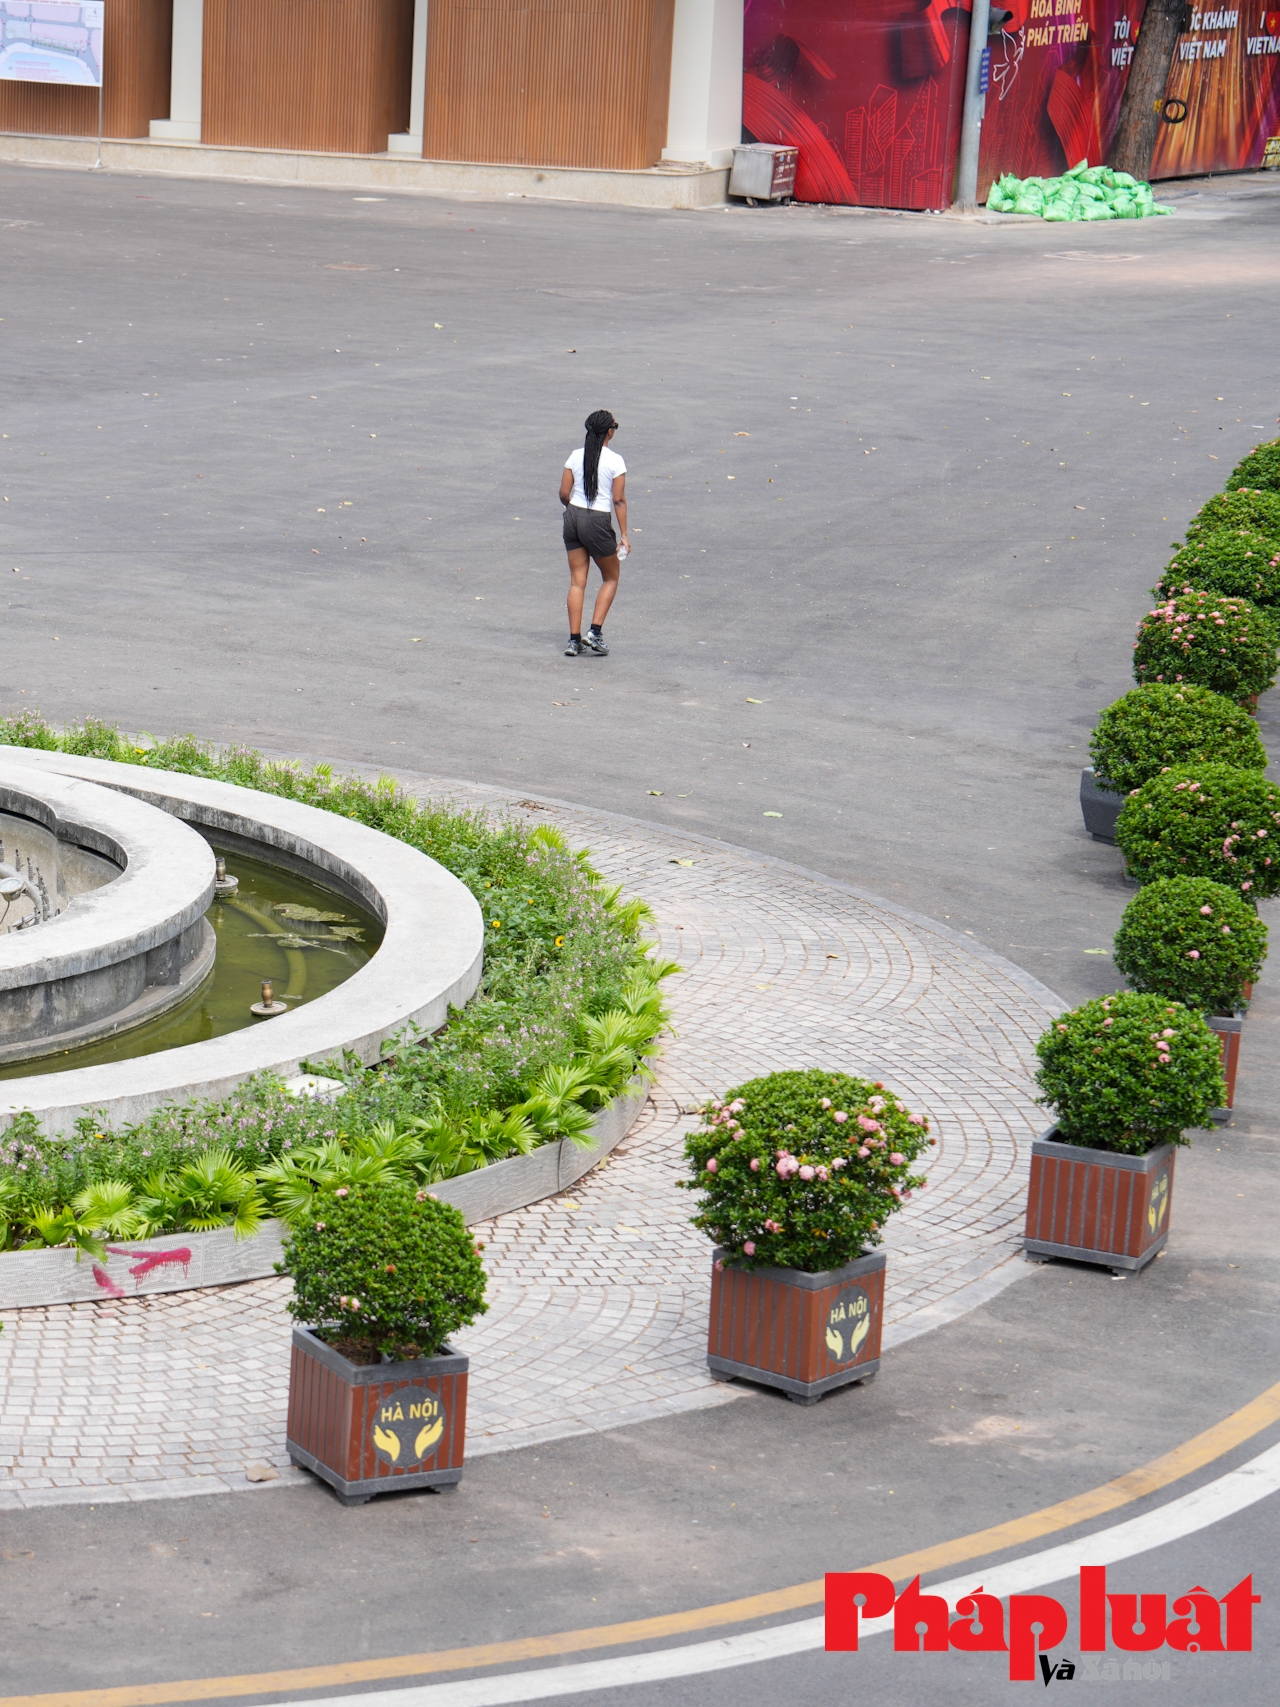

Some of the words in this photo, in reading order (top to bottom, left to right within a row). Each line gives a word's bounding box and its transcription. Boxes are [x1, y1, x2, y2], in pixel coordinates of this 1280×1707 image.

[1114, 15, 1131, 40] TÔI
[1202, 5, 1239, 30] KHÁNH
[1260, 11, 1266, 29] I
[1026, 21, 1056, 48] PHÁT
[1057, 16, 1089, 44] TRIỂN
[1111, 41, 1135, 70] VIỆT
[1180, 36, 1203, 64] VIỆT
[1203, 39, 1227, 59] NAM
[830, 1302, 847, 1324] HÀ
[848, 1295, 868, 1318] NỘI
[380, 1402, 405, 1423] HÀ
[409, 1398, 439, 1421] NỘI
